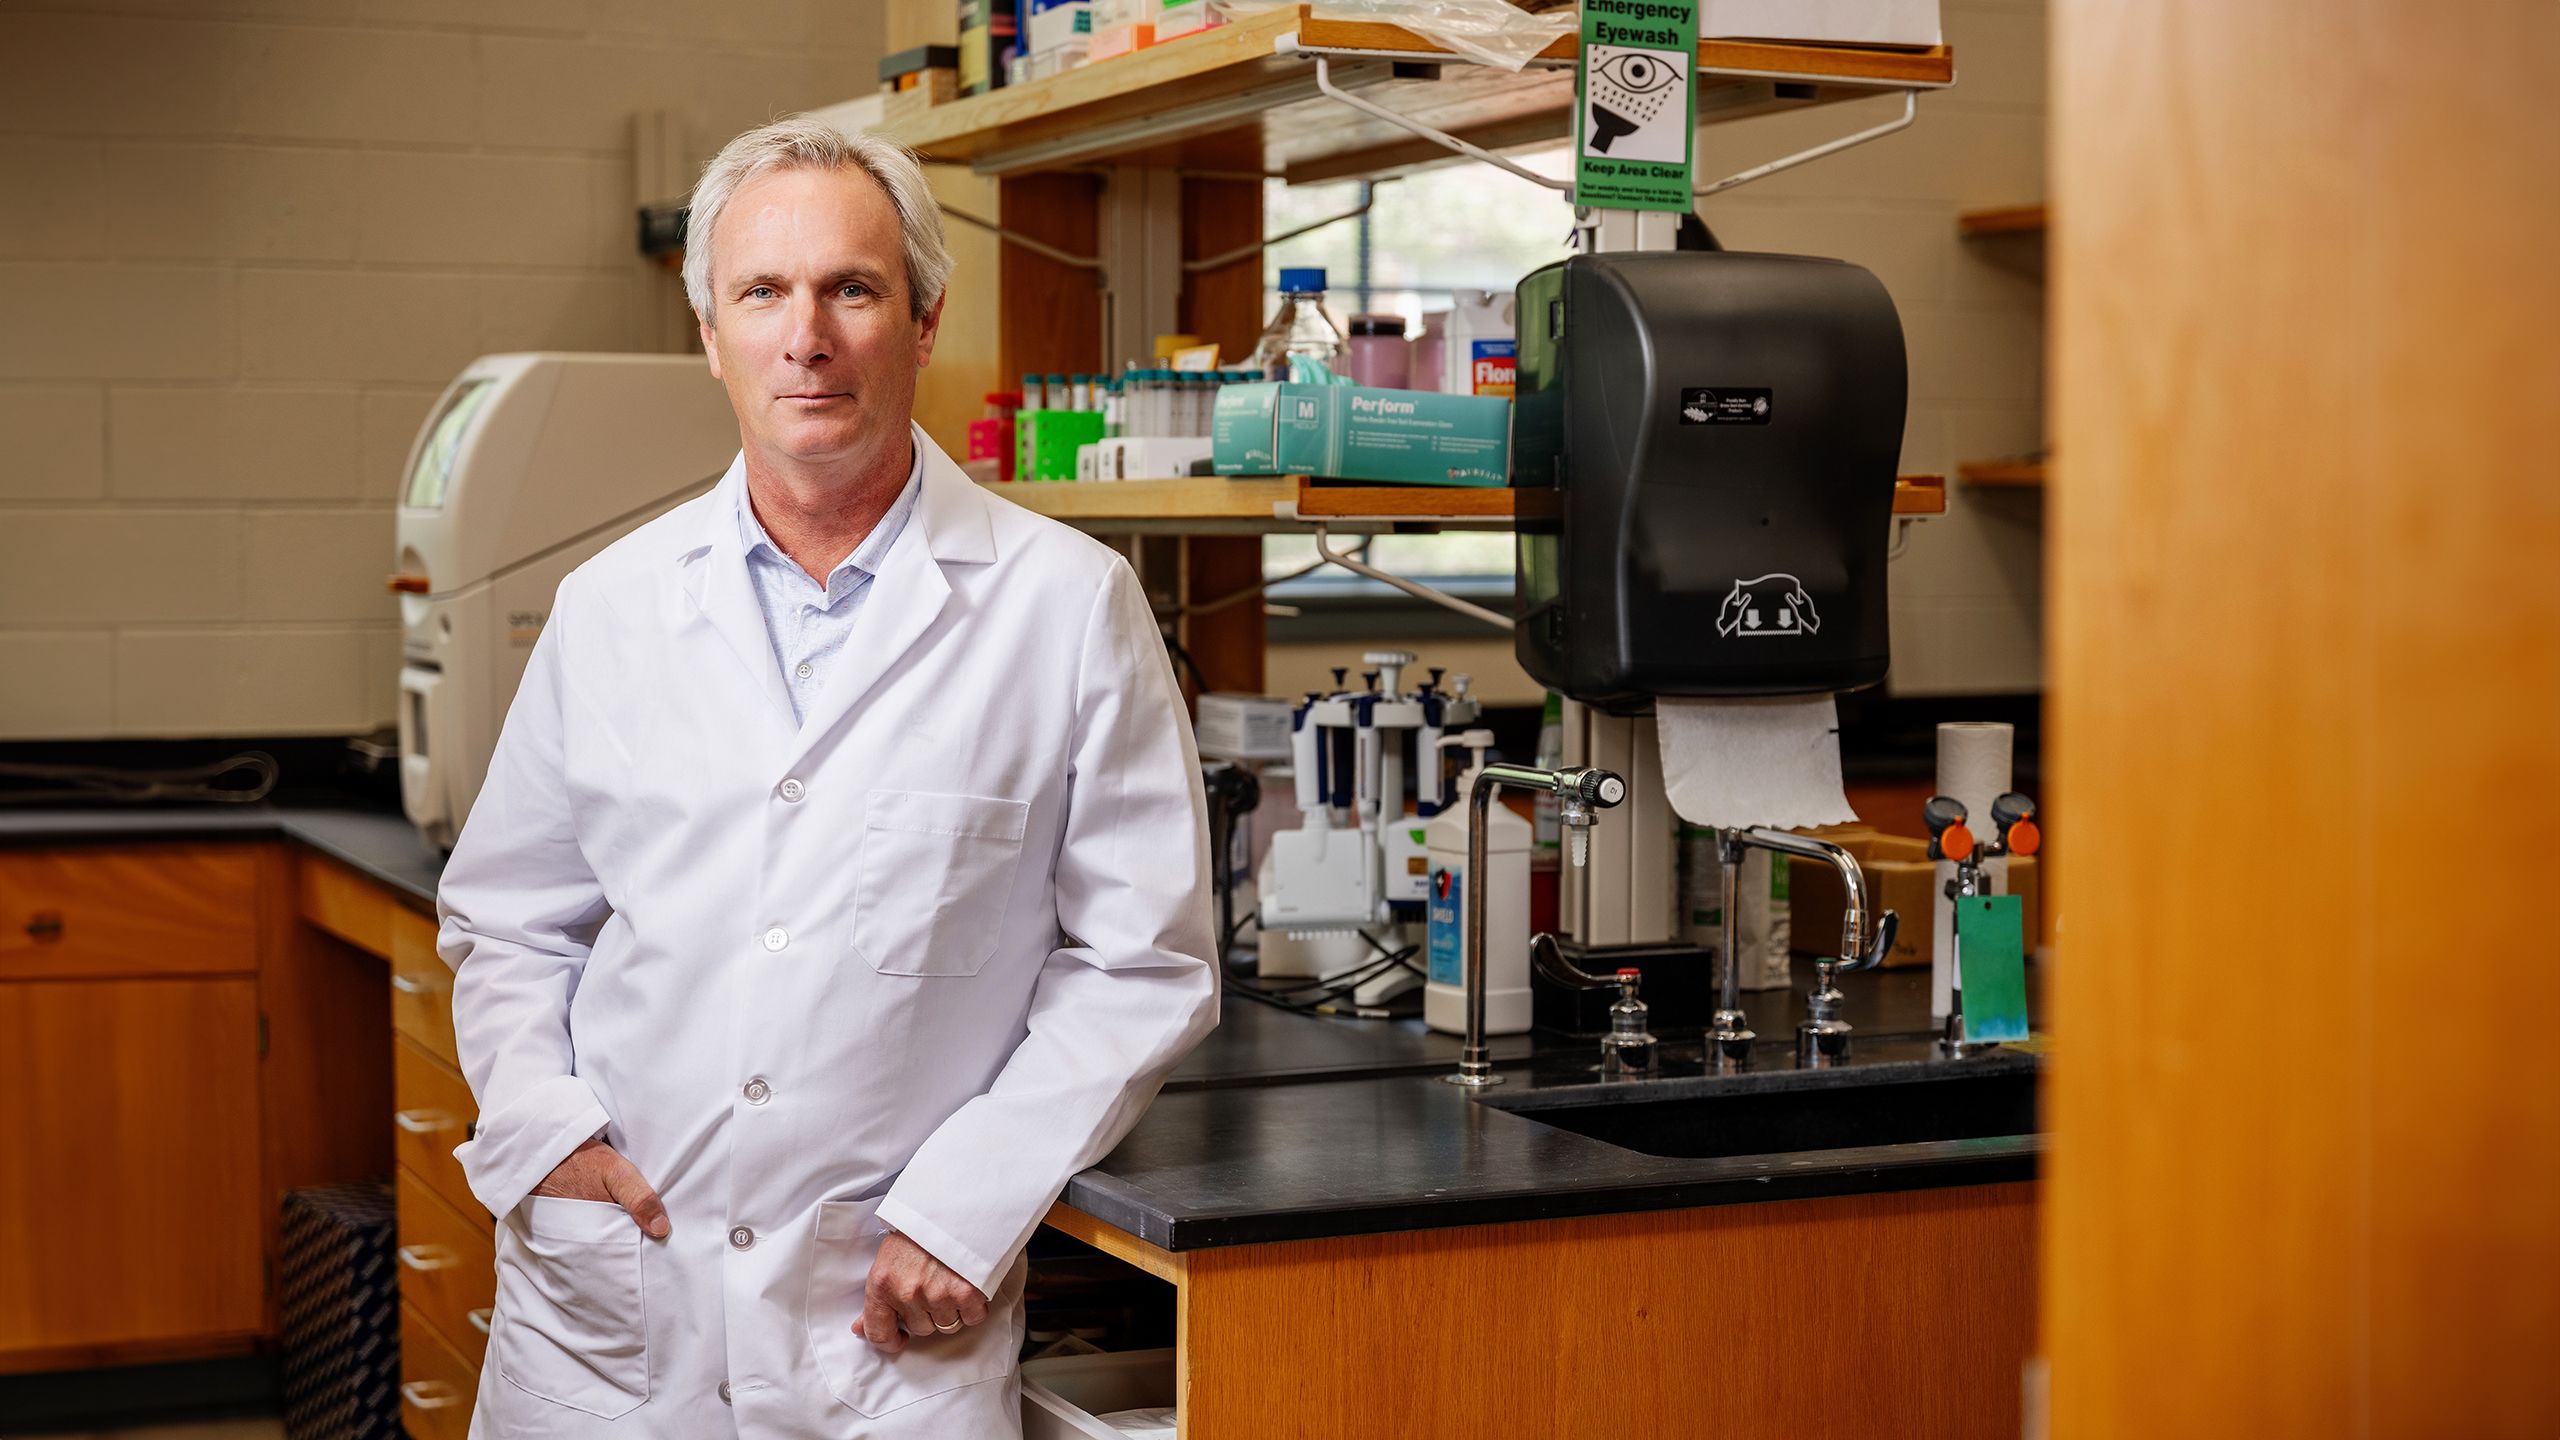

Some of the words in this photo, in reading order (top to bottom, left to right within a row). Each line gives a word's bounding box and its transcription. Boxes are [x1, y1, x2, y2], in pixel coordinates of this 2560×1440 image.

[1586, 0, 1691, 24] Emergency
[1596, 21, 1679, 45] Eyewash
[1584, 161, 1616, 176] Keep
[1619, 164, 1648, 176] Area
[1651, 166, 1684, 179] Clear
[1298, 401, 1314, 419] M
[1352, 396, 1414, 415] Perform
